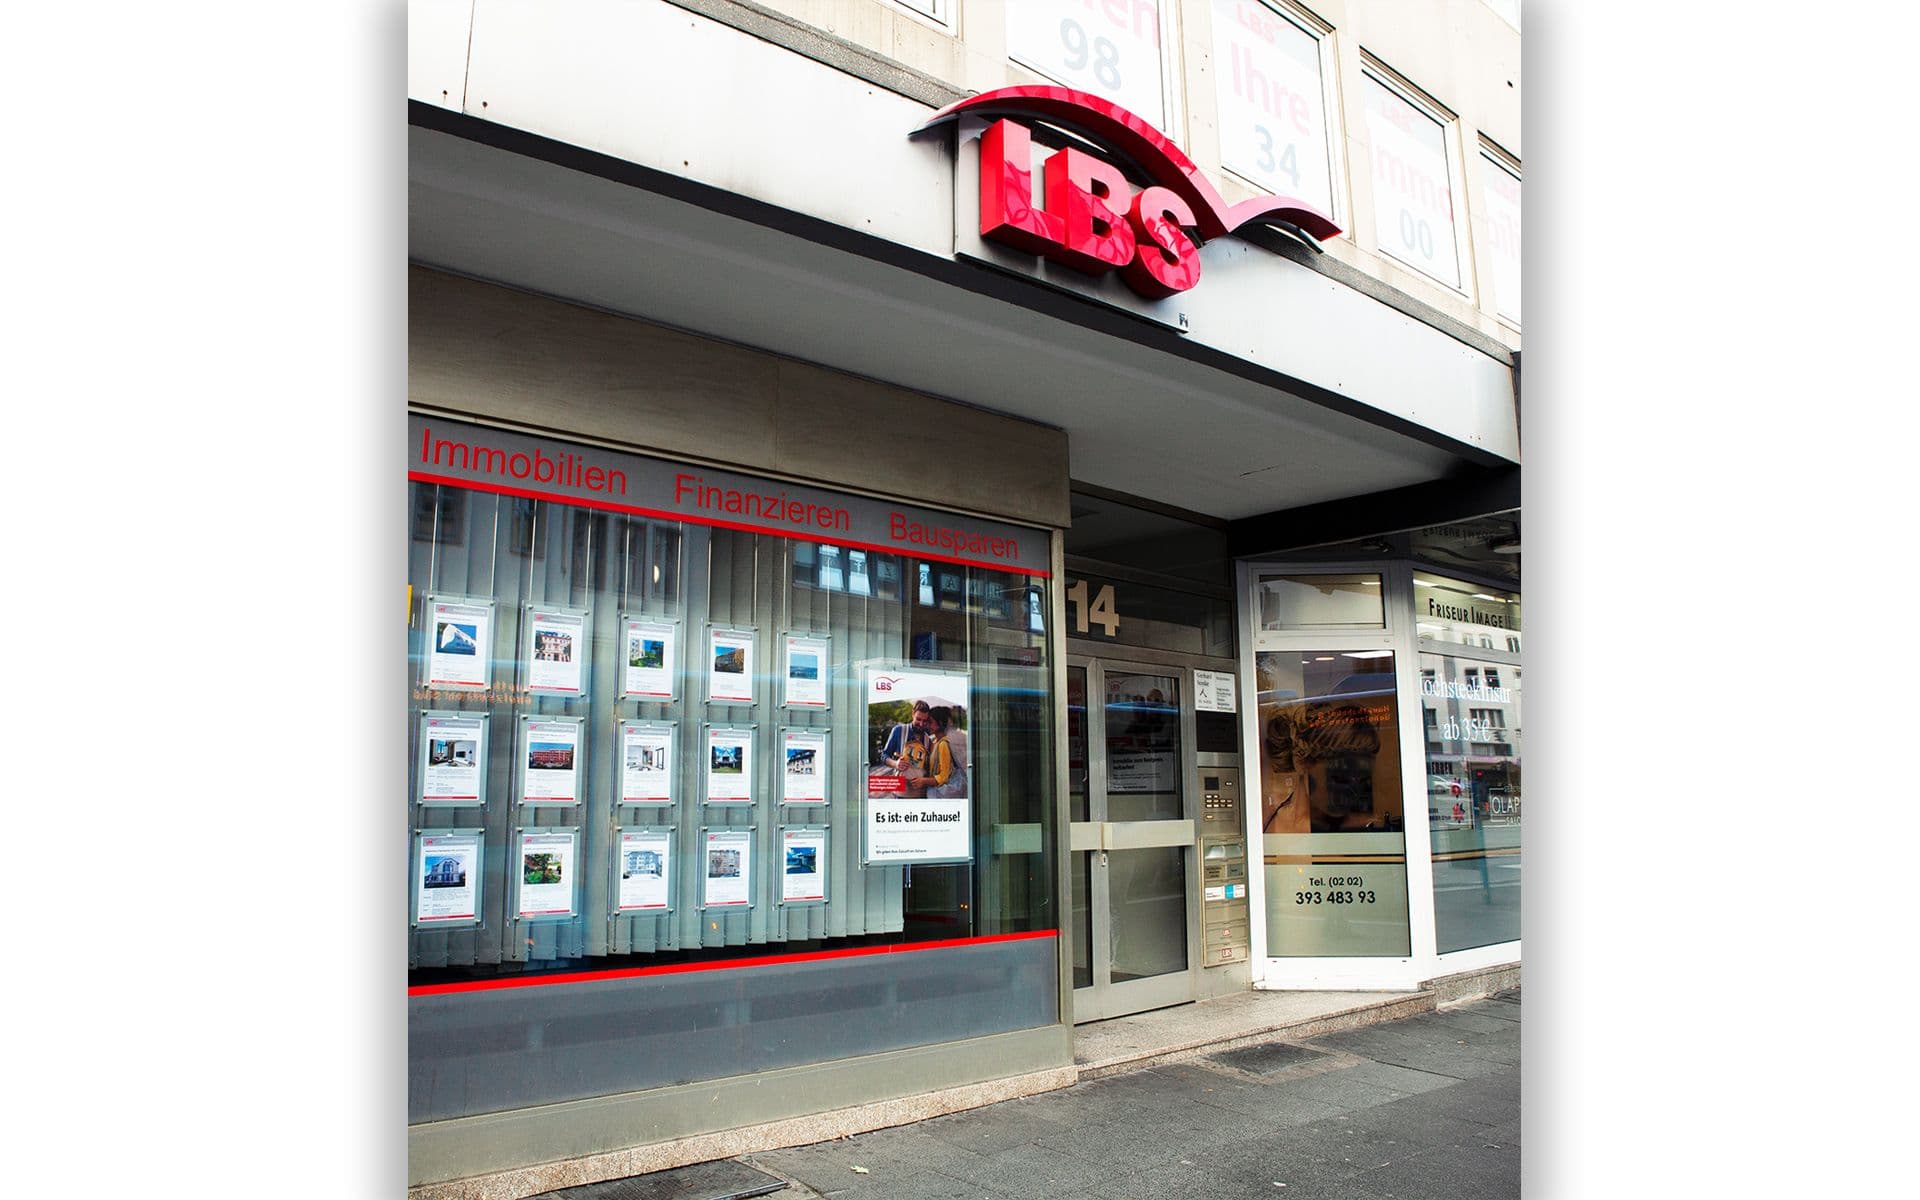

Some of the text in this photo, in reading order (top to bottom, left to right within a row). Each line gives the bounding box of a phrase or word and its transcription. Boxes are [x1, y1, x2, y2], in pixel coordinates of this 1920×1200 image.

[1060, 17, 1121, 91] 98
[1231, 34, 1310, 136] Ihre
[1254, 123, 1302, 187] 34
[980, 118, 1202, 299] LBS
[1399, 207, 1433, 260] 00
[421, 427, 627, 496] Immobilien
[674, 472, 851, 532] Finanzieren
[889, 511, 1020, 560] Bausparen
[1067, 580, 1120, 637] 14
[1428, 598, 1469, 624] FRISEUR
[1471, 606, 1504, 628] IMAGE
[875, 681, 892, 692] LBS
[1443, 715, 1460, 741] ab
[875, 810, 961, 823] Es ist: ein Zuhause!
[1295, 890, 1376, 905] 393 483 93
[1309, 876, 1363, 888] Tel. (02 02)
